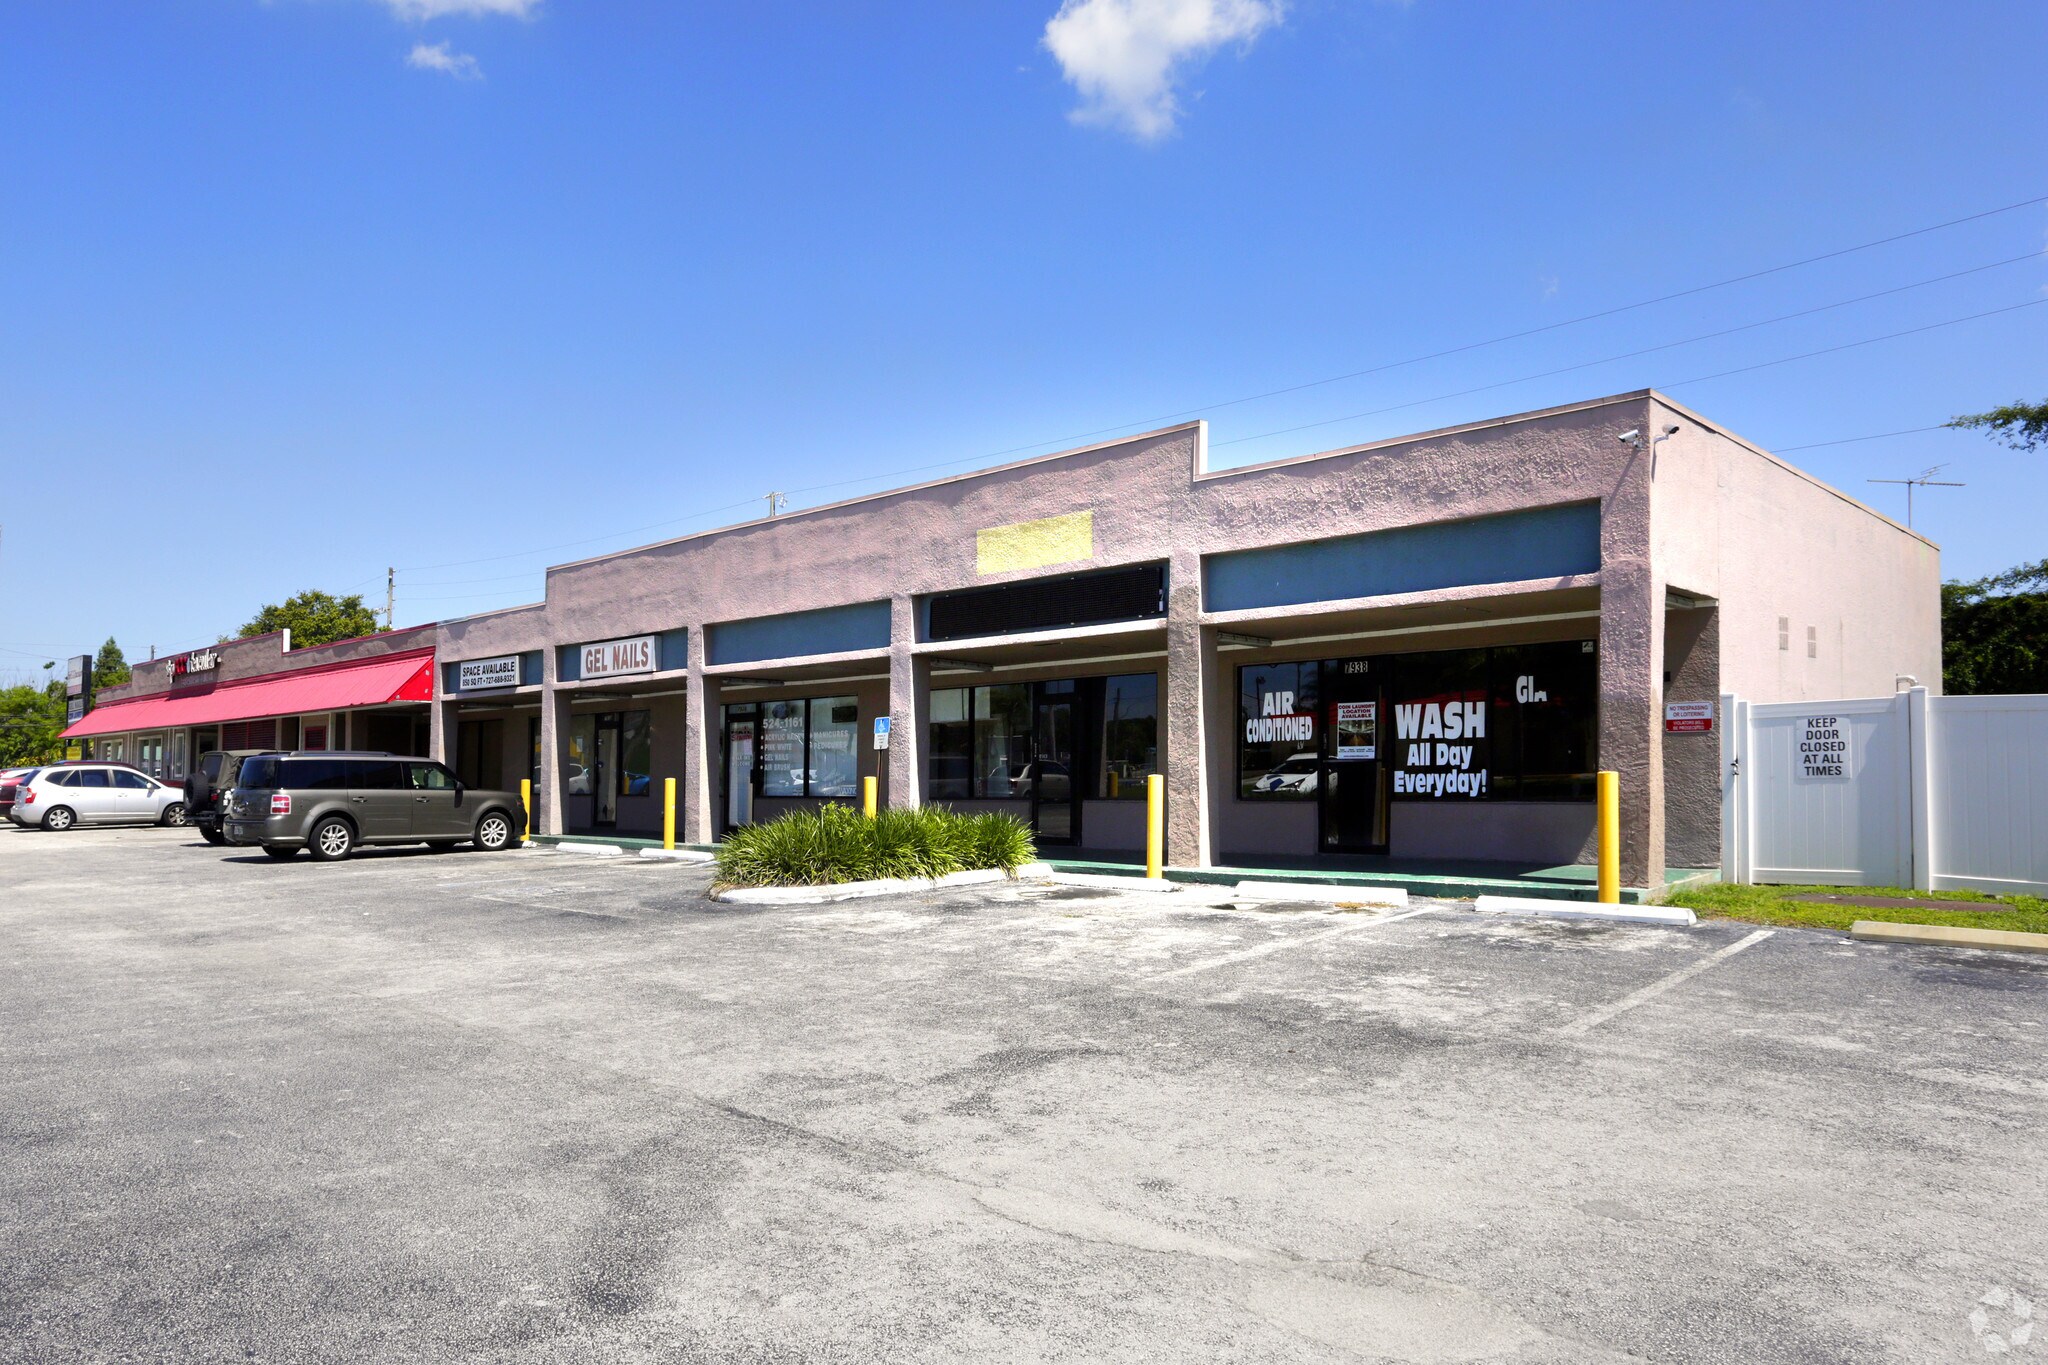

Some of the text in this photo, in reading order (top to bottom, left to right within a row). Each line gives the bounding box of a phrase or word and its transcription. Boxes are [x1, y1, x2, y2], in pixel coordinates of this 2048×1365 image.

[585, 640, 649, 674] GEL NAILS
[462, 661, 515, 677] SPACE AVAILABLE
[1344, 660, 1368, 673] 7938
[470, 677, 477, 686] SQ
[477, 677, 483, 685] FT
[1262, 691, 1295, 716] AIR
[763, 717, 803, 729] 524-1161
[1395, 701, 1486, 740] WASH
[1807, 717, 1837, 728] KEEP
[813, 730, 849, 740] MANICURES
[1246, 716, 1313, 743] CONDITIONED
[1805, 729, 1840, 740] DOOR
[1800, 741, 1846, 752] CLOSED
[1407, 742, 1473, 770] All Day
[1803, 753, 1844, 764] AT ALL
[1804, 765, 1842, 776] TIMES
[1394, 769, 1488, 797] Everyday!
